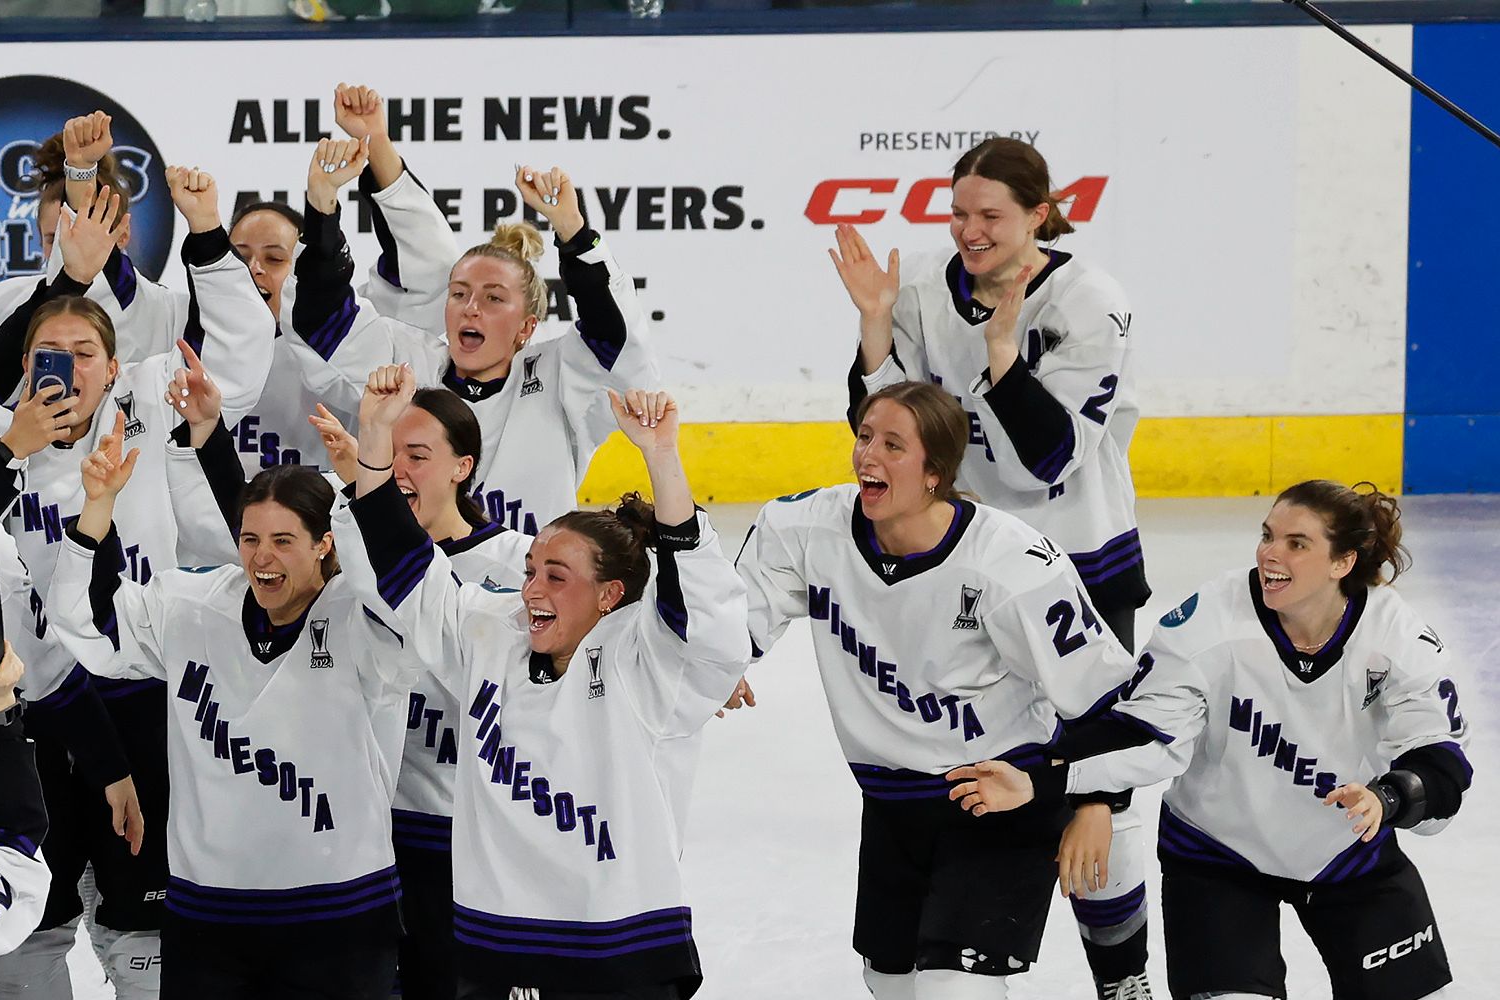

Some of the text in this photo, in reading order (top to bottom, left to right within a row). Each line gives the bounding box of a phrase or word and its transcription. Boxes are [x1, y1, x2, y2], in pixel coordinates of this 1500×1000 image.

[229, 95, 672, 144] ALL HE NEWS.
[349, 187, 462, 234] TE
[310, 657, 335, 670] 2024
[807, 583, 987, 744] MINNESOTA
[177, 660, 336, 834] MINNESOTA
[468, 679, 617, 863] MINNESOTA
[1228, 695, 1349, 809] MINNES
[1362, 924, 1434, 970] CCM
